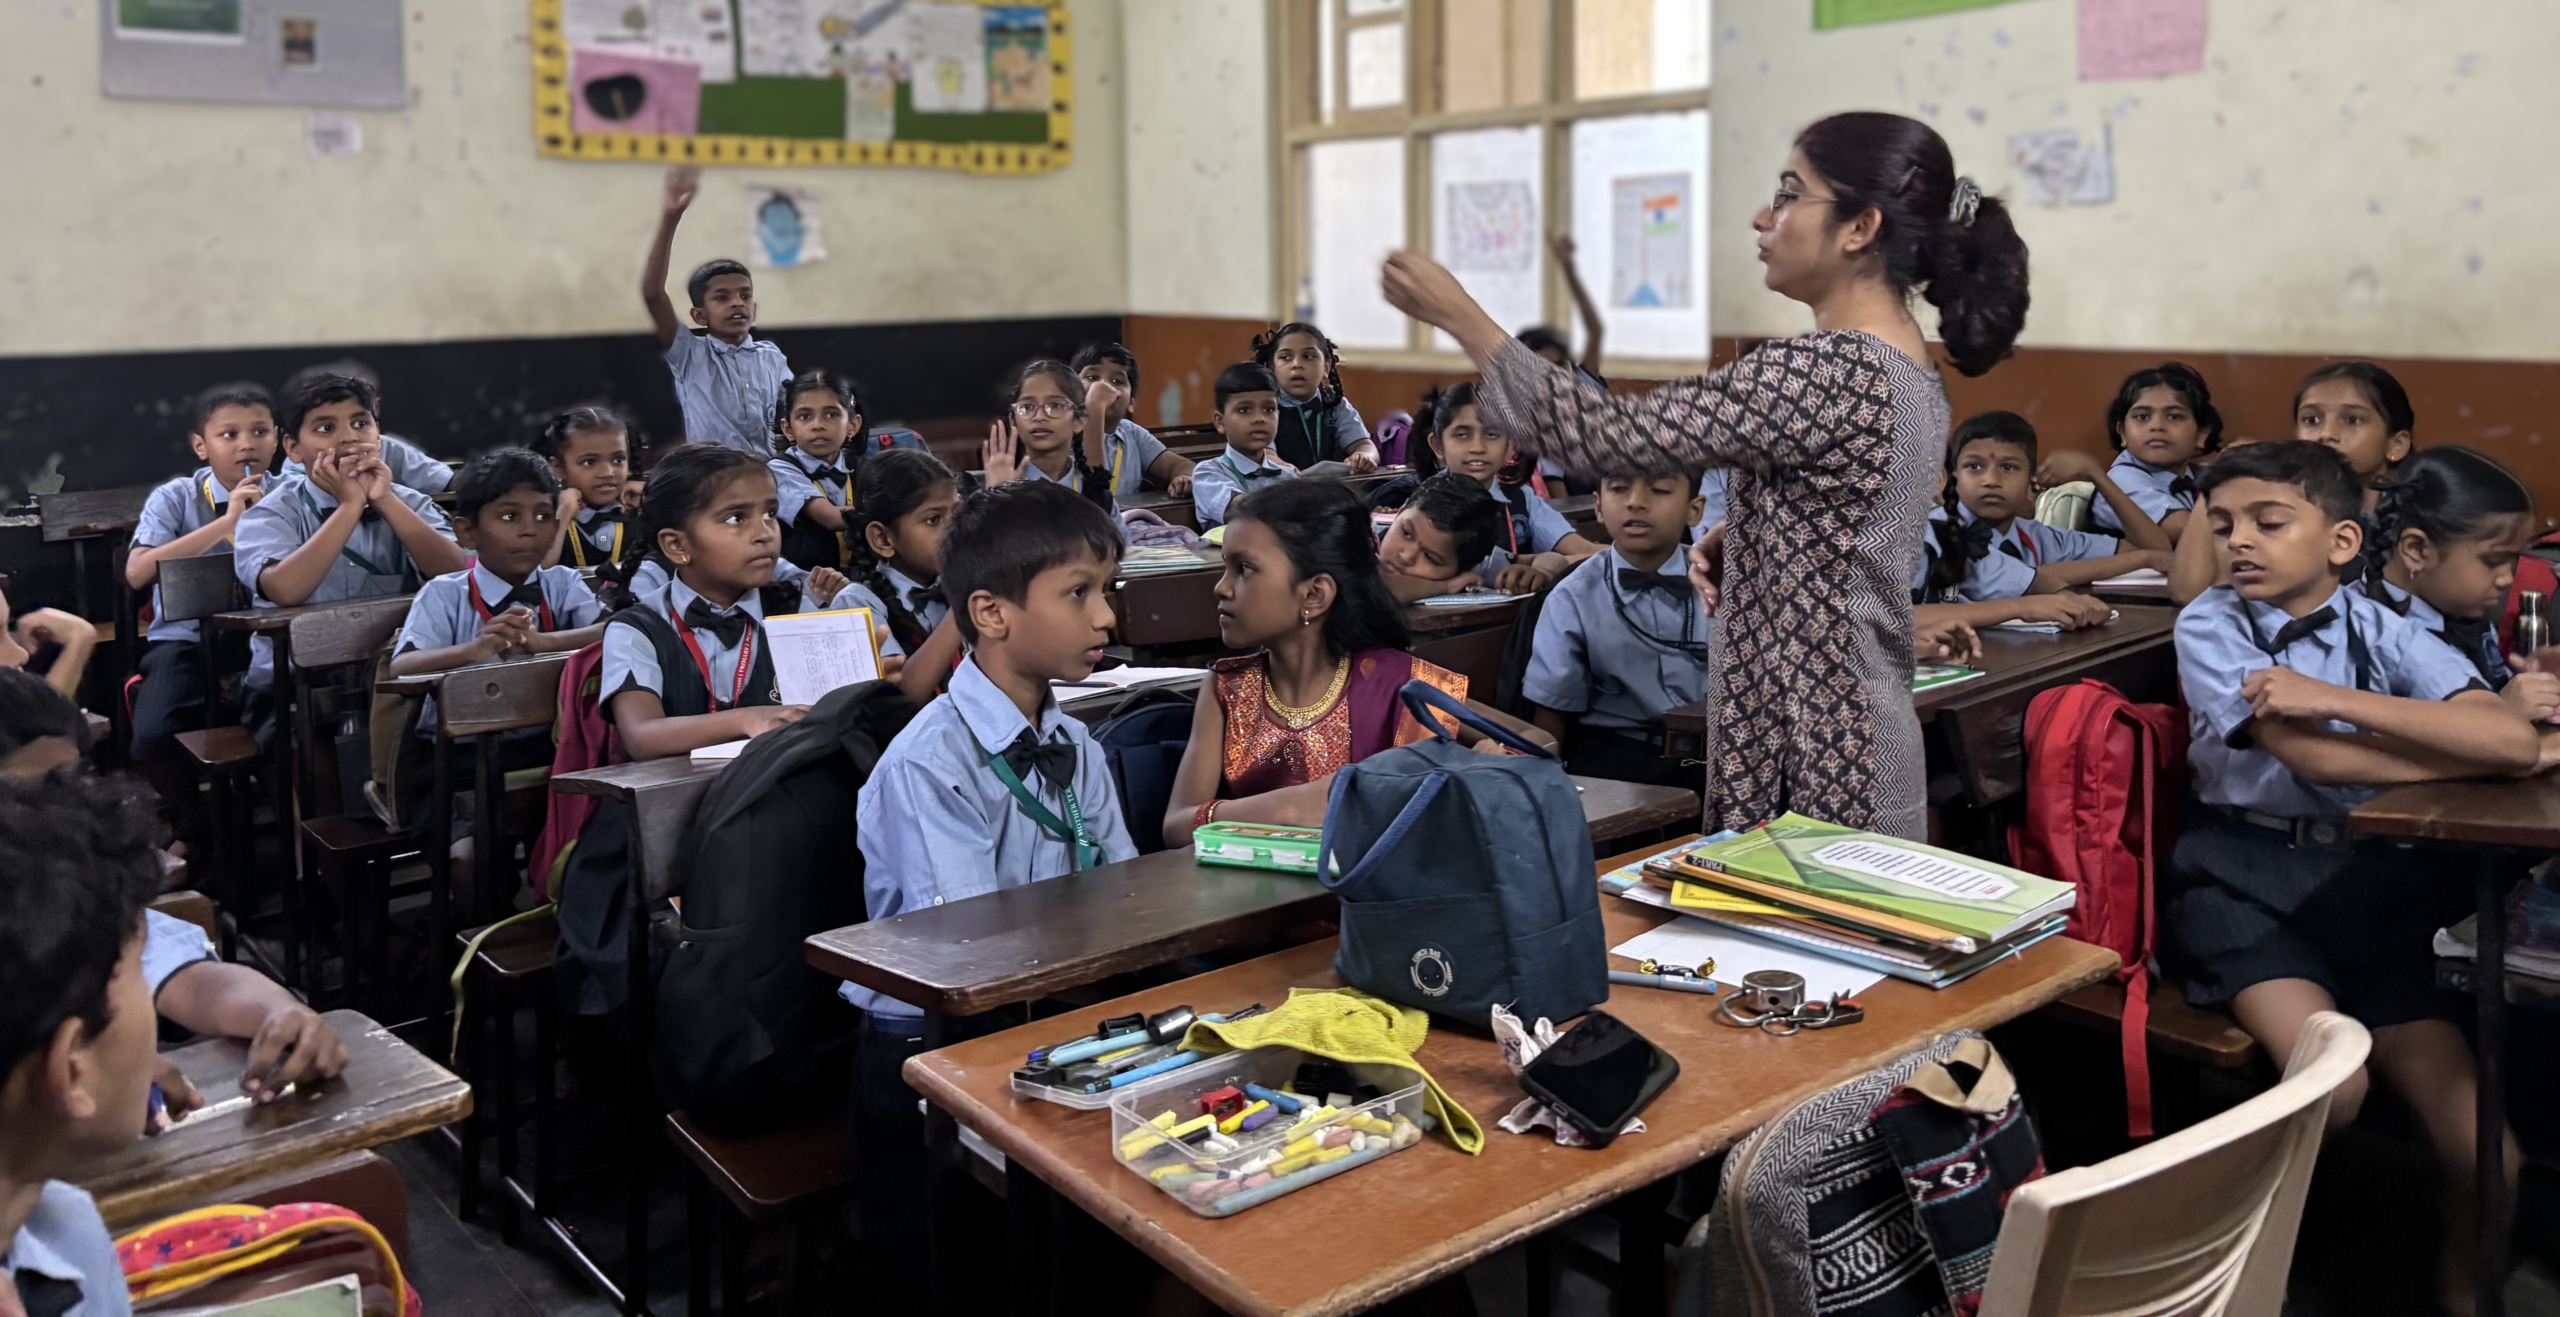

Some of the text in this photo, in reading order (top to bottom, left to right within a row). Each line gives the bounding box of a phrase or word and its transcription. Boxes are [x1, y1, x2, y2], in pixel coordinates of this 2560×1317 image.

[1065, 788, 1075, 803] TER
[1070, 803, 1084, 837] MOTHER
[1692, 856, 1723, 872] PART-2
[1429, 948, 1441, 960] BAG
